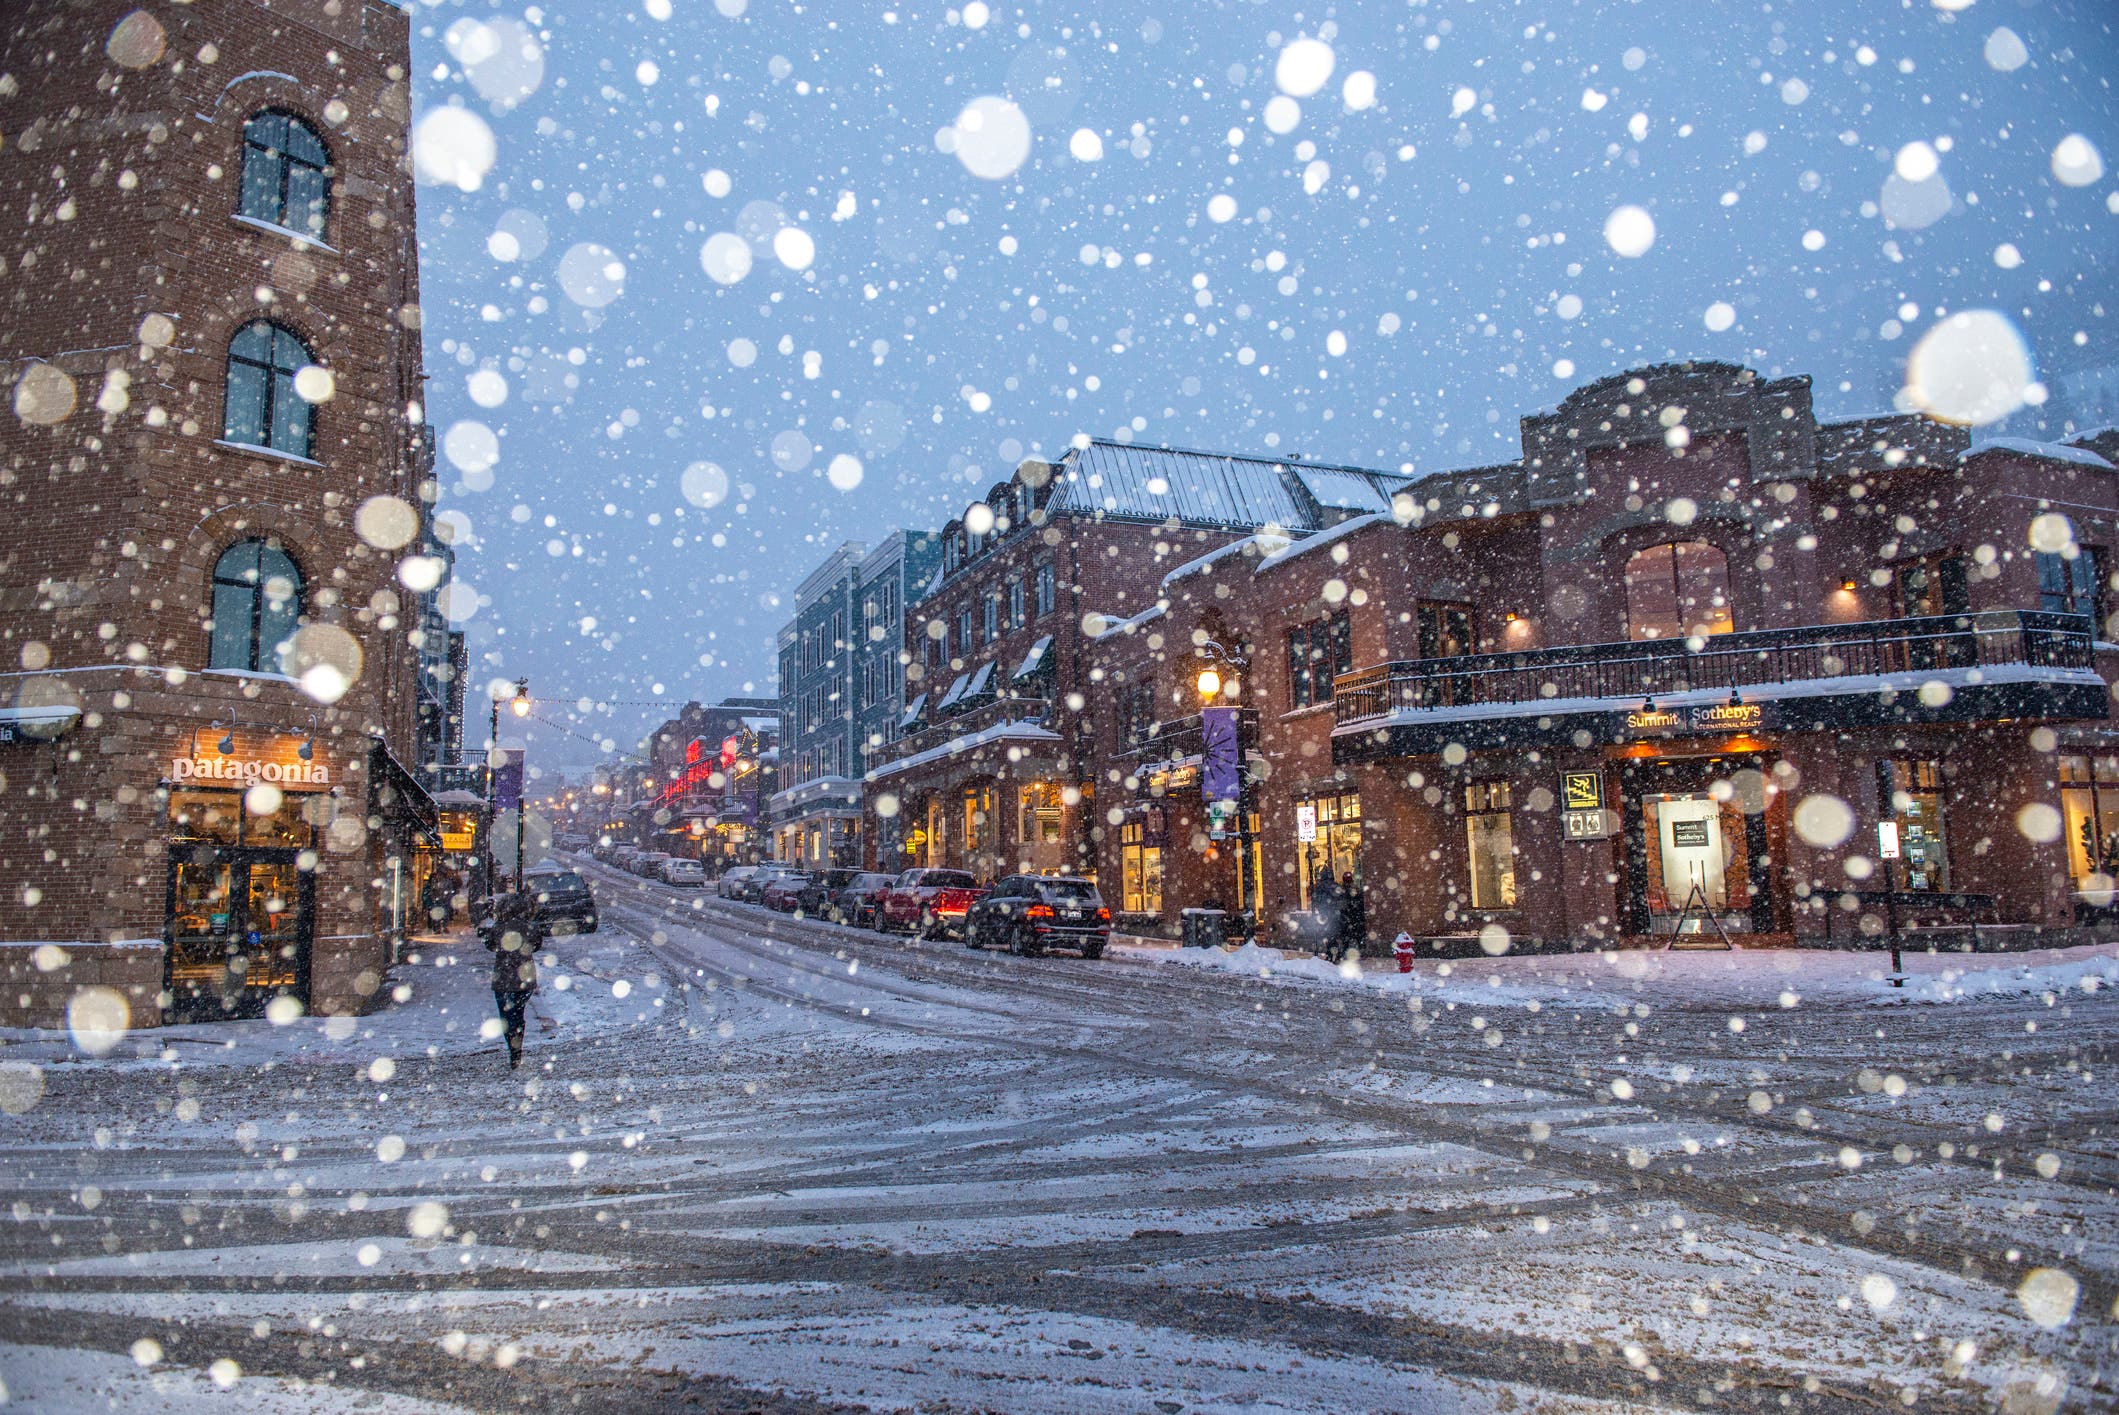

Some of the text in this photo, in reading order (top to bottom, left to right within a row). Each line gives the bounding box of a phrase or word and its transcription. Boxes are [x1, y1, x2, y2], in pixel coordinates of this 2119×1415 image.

[1627, 705, 1761, 728] Summit Sotheby's
[1740, 720, 1763, 728] REALTY
[172, 756, 329, 787] patagonia
